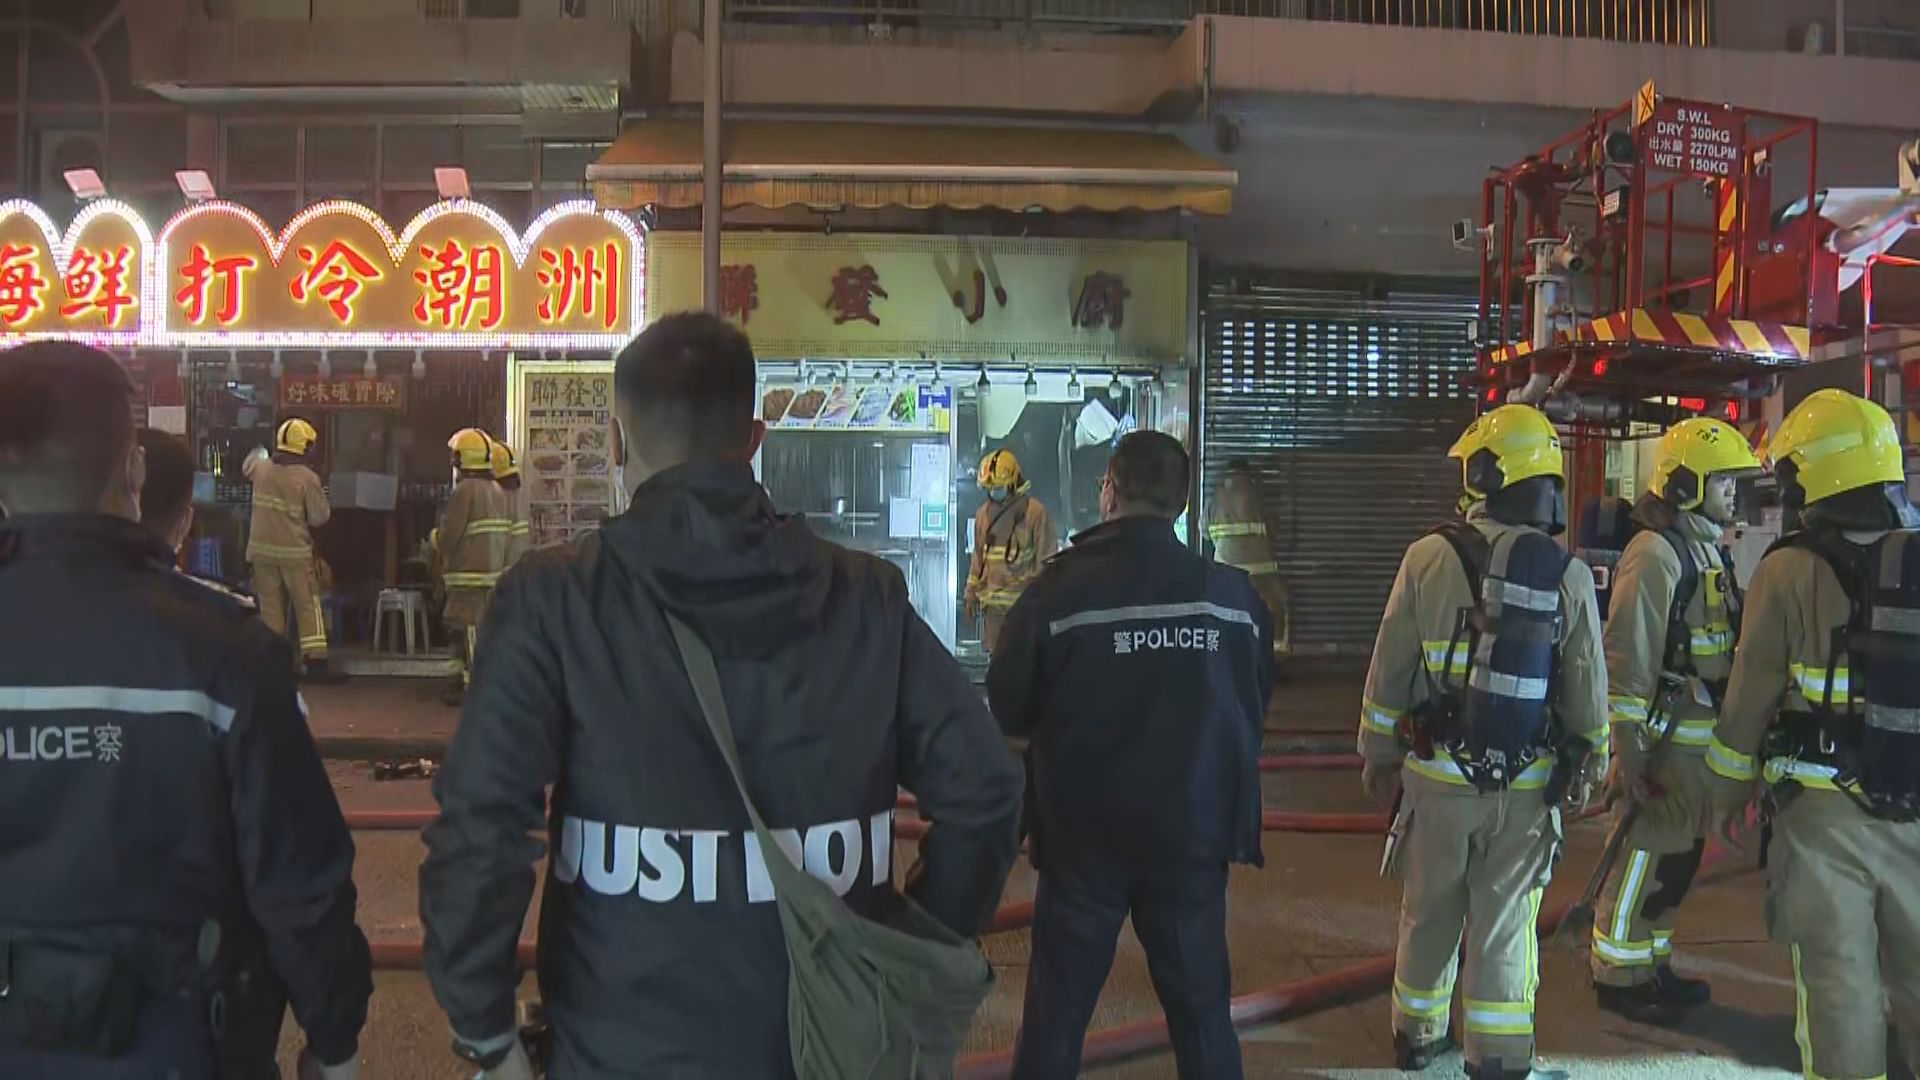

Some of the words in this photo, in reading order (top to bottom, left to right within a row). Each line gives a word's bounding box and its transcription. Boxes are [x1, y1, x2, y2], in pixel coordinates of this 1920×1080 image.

[1657, 121, 1684, 137] DRY
[1690, 126, 1730, 143] 300KG
[1648, 136, 1683, 153] 出水量
[1690, 142, 1737, 160] 2270LPM
[1654, 152, 1683, 169] WET
[1689, 158, 1729, 175] 150KG
[175, 240, 622, 330] 打冷潮洲
[555, 816, 730, 903] JUST
